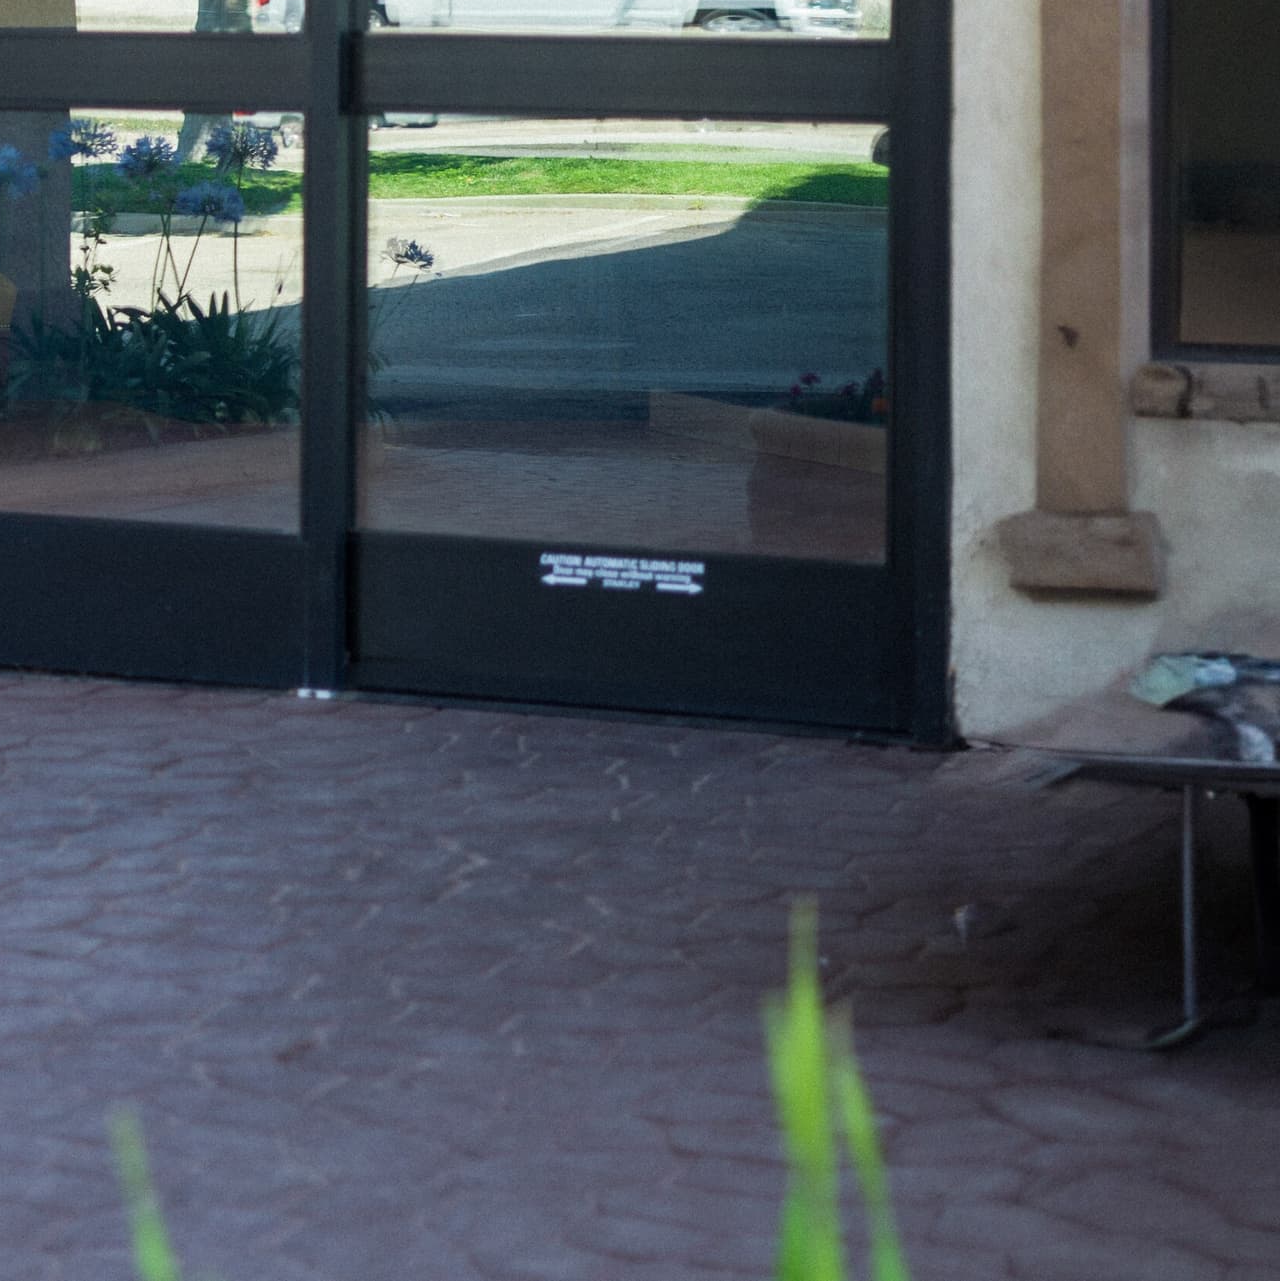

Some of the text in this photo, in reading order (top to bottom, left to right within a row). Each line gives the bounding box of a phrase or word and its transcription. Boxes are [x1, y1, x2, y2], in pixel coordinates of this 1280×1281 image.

[583, 556, 638, 570] AUTOMATIC
[639, 559, 676, 573] SLIDING
[677, 561, 705, 575] DOOR
